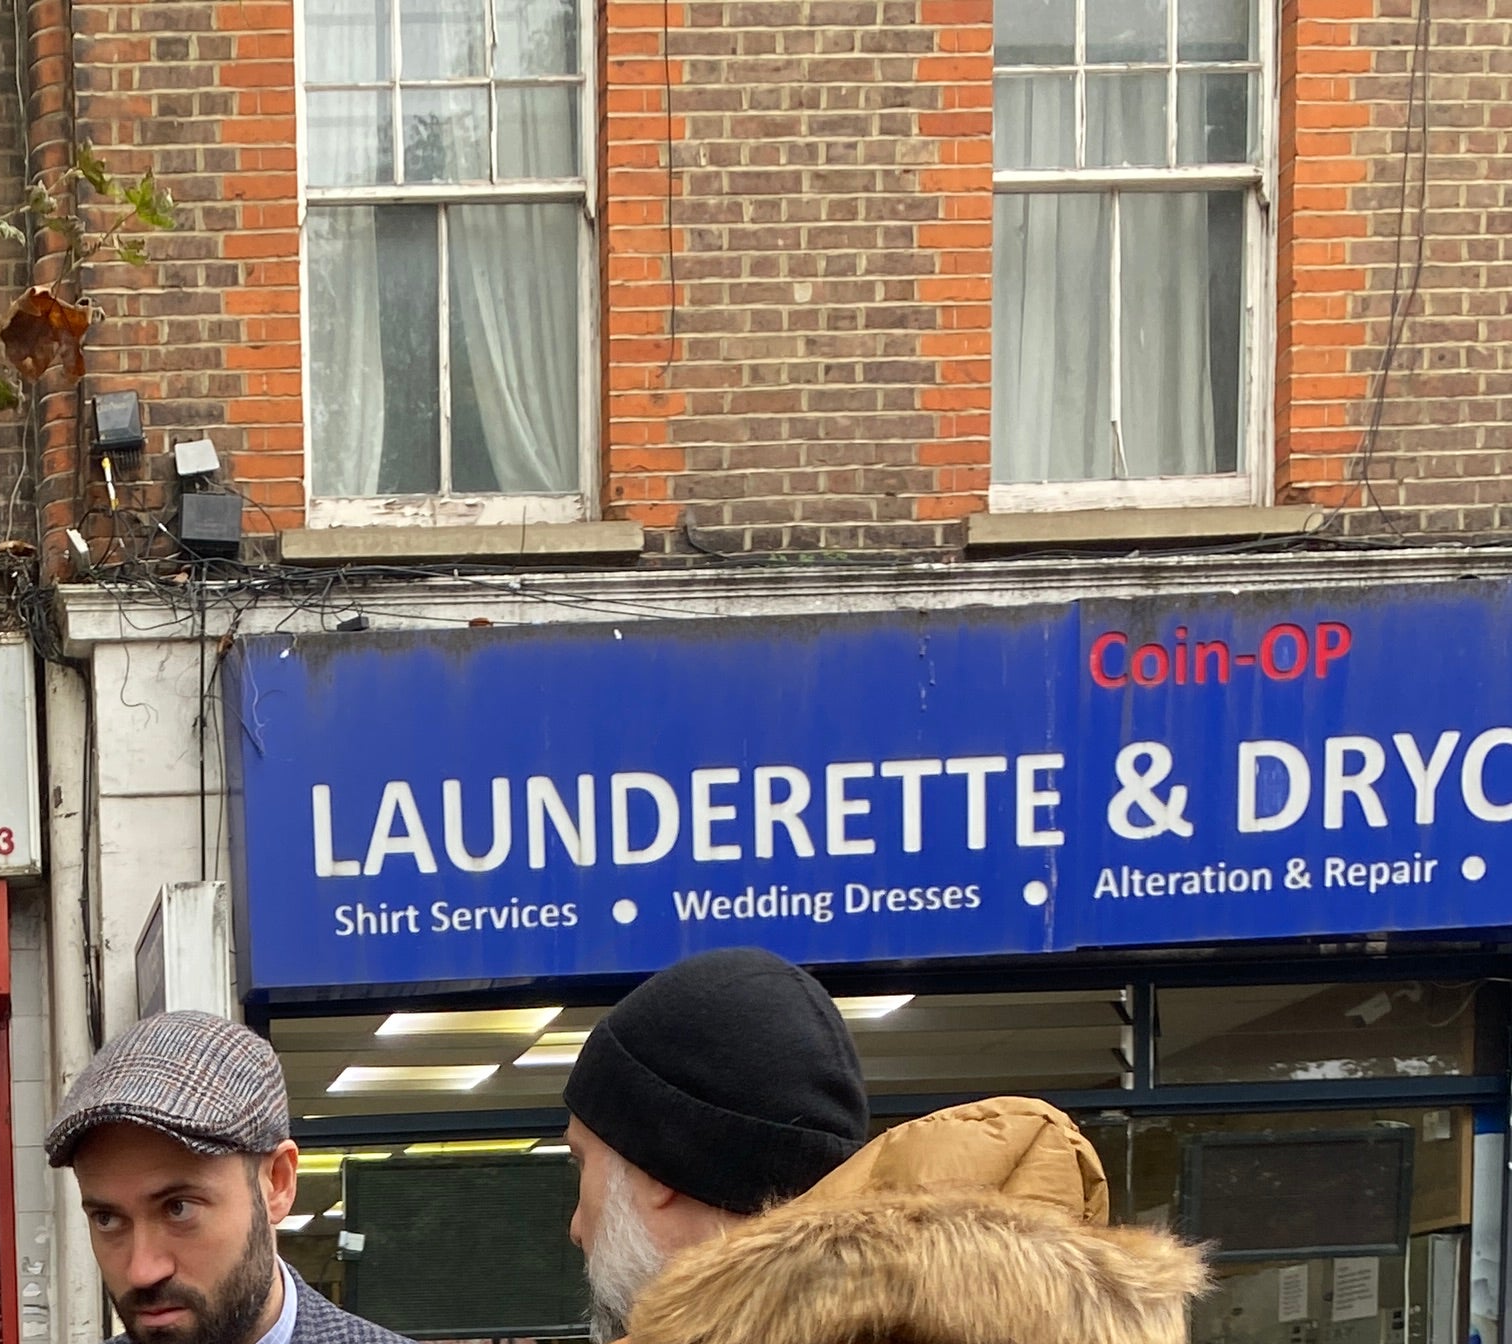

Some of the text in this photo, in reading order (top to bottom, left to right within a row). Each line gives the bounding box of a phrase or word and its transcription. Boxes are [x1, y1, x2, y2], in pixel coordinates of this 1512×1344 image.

[1088, 621, 1353, 690] Coin-OP
[311, 752, 1066, 878] LAUNDERETTE
[1106, 739, 1195, 840] &
[335, 852, 1438, 937] Shirt Services Wedding Dresses Alteration & Repair
